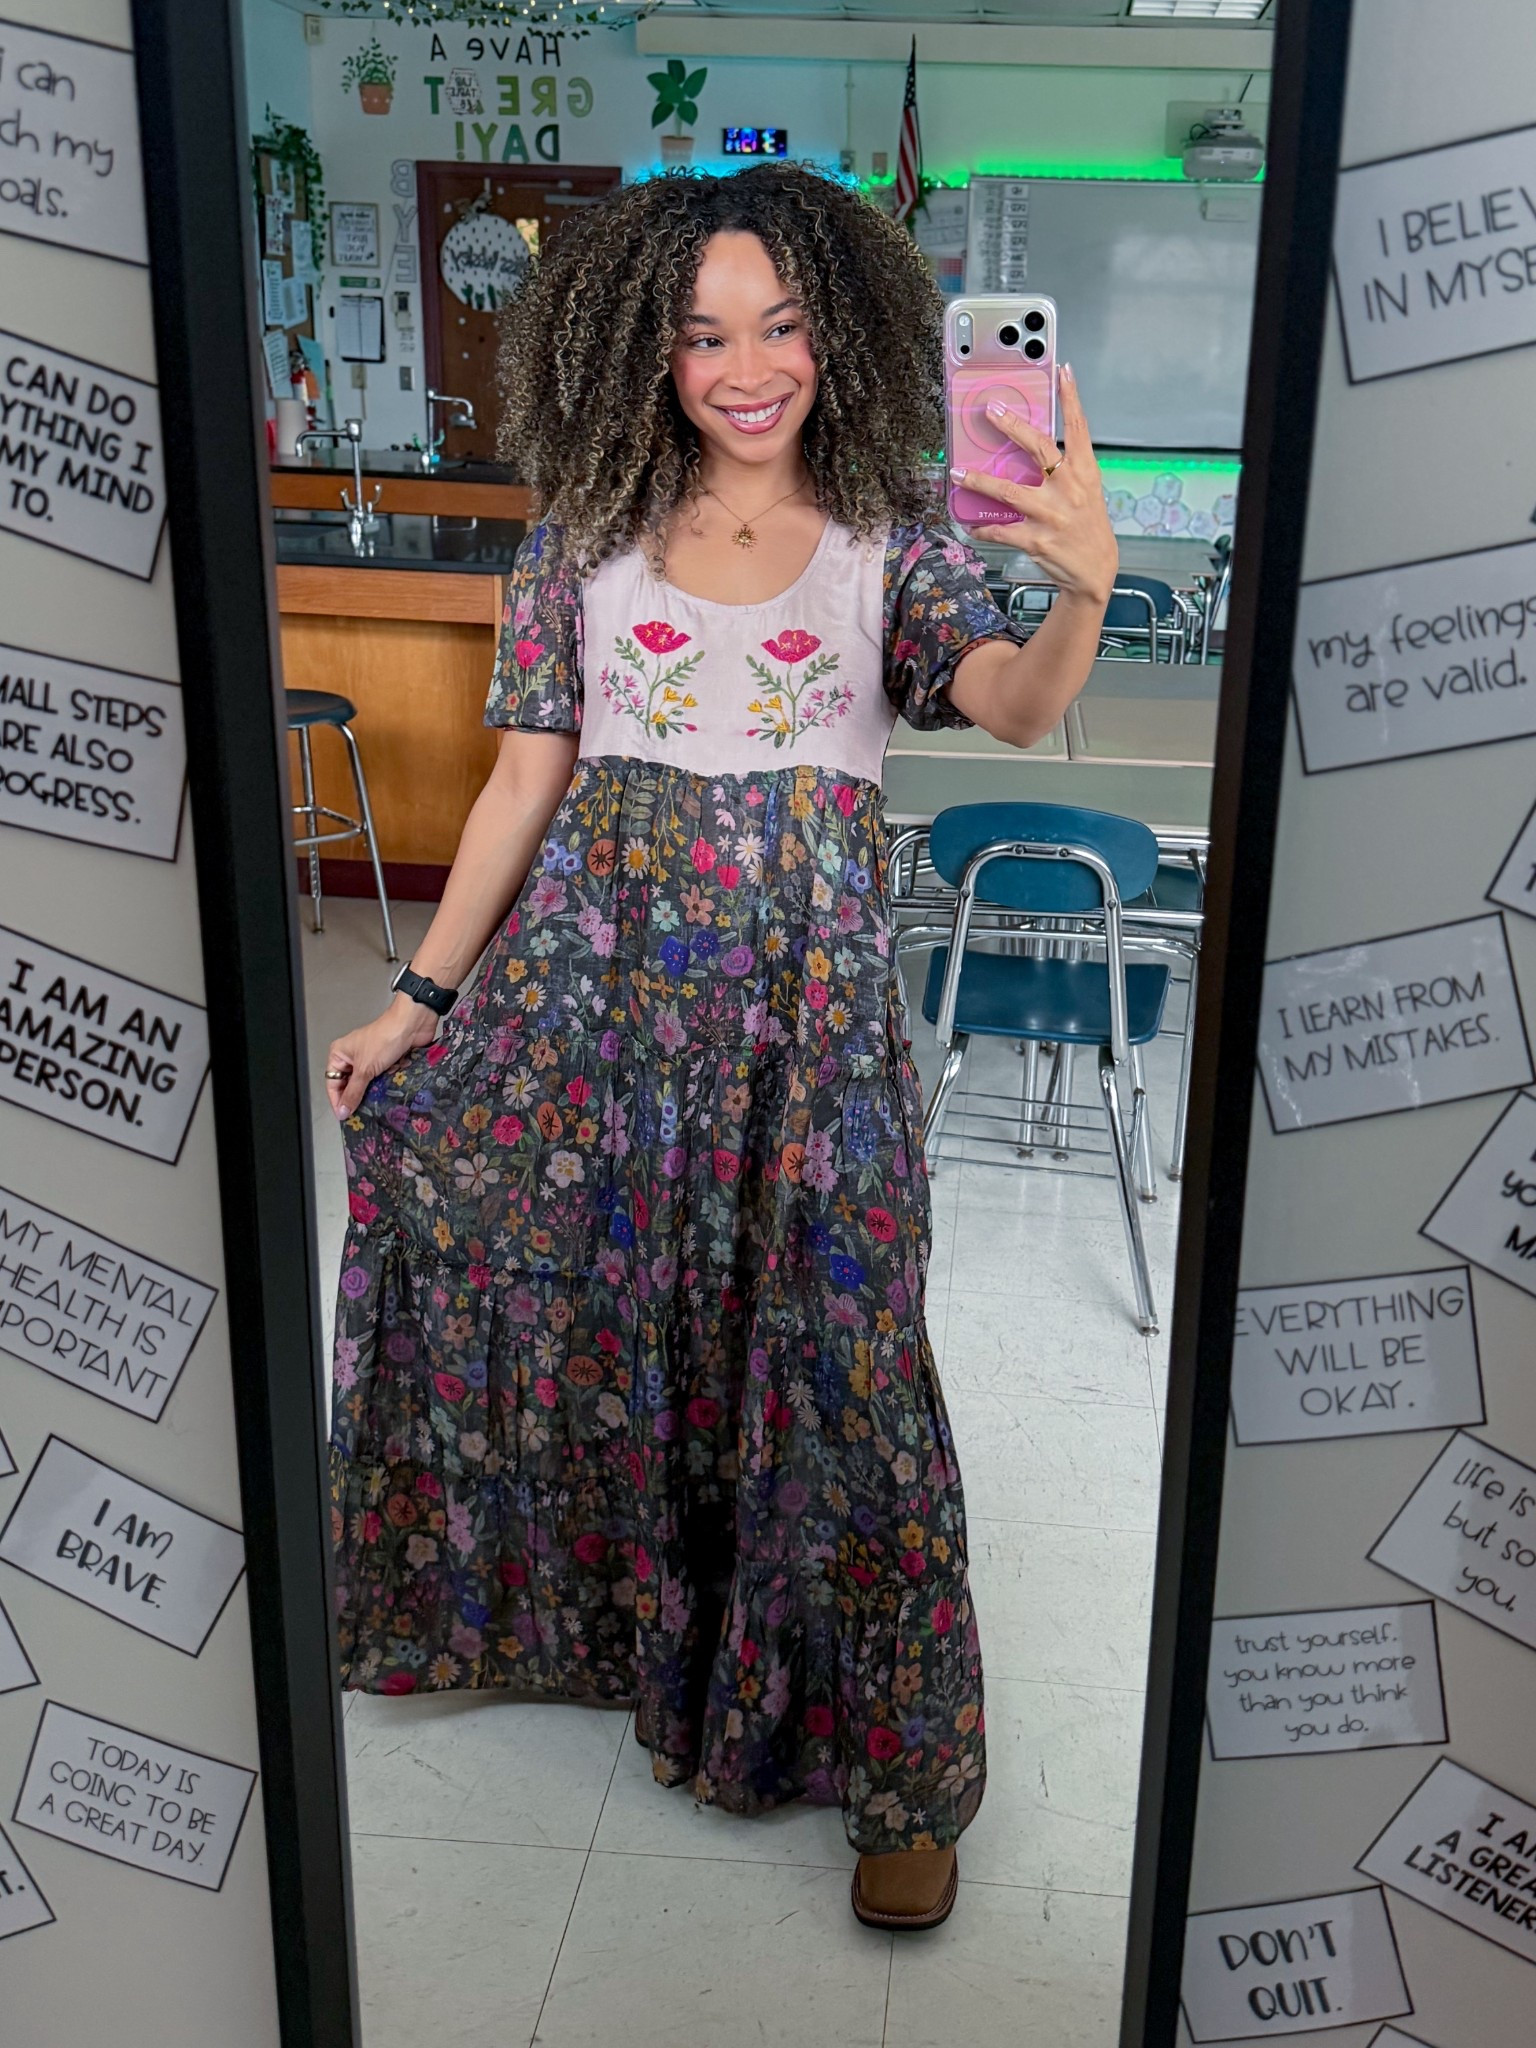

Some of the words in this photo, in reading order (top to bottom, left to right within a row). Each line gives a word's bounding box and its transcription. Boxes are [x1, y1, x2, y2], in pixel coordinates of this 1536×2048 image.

[17, 62, 75, 101] can
[53, 131, 114, 178] my
[0, 178, 68, 217] oals.
[1379, 218, 1389, 258] I
[1364, 272, 1408, 324] IN
[6, 357, 79, 406] CAN
[87, 384, 137, 426] DO
[0, 393, 122, 463] YTHING
[130, 441, 154, 475] I
[0, 434, 50, 477] MY
[57, 457, 155, 515] MIND
[10, 478, 54, 523] TO.
[1308, 631, 1376, 669] my
[1346, 678, 1409, 712] are
[1422, 647, 1527, 701] valid.
[70, 689, 167, 738] STEPS
[0, 719, 42, 754] RE
[50, 733, 134, 773] ALSO
[0, 765, 141, 824] OGRESS.
[8, 958, 35, 995] I
[41, 976, 110, 1026] AM
[119, 1008, 182, 1053] AN
[1278, 1008, 1293, 1039] I
[1299, 991, 1385, 1035] LEARN
[1393, 972, 1485, 1016] FROM
[0, 997, 179, 1094] AMAZING
[1283, 1044, 1332, 1082] MY
[1342, 1012, 1500, 1071] MISTAKES.
[0, 1038, 143, 1127] PERSON.
[0, 1208, 54, 1253] MY
[59, 1240, 193, 1327] MENTAL
[0, 1254, 128, 1339] HEALTH
[132, 1321, 166, 1356] IS
[1234, 1286, 1465, 1337] EVERYTHING
[0, 1300, 168, 1399] PORTANT
[1274, 1341, 1368, 1376] WILL
[1381, 1334, 1425, 1368] BE
[1300, 1380, 1415, 1417] OKAY.
[93, 1498, 111, 1527] I
[1452, 1459, 1504, 1500] life
[1508, 1487, 1536, 1518] is
[1443, 1500, 1498, 1549] but
[56, 1528, 167, 1609] BRAVE.
[1455, 1566, 1516, 1612] you.
[1235, 1631, 1290, 1654] trust
[1296, 1621, 1398, 1654] yourself.
[1224, 1667, 1268, 1688] you
[1275, 1662, 1346, 1681] know
[1353, 1654, 1416, 1673] more
[1239, 1693, 1292, 1713] than
[1298, 1692, 1344, 1712] you
[1350, 1683, 1409, 1703] think
[1285, 1722, 1329, 1742] you
[1337, 1713, 1370, 1733] do.
[87, 1736, 172, 1785] TODAY
[174, 1768, 200, 1795] IS
[38, 1793, 55, 1815] A
[65, 1800, 148, 1846] GREAT
[50, 1760, 137, 1807] GOING
[146, 1793, 181, 1824] TO
[187, 1808, 216, 1836] BE
[1435, 1829, 1461, 1854] A
[1477, 1812, 1505, 1838] I
[1247, 1976, 1343, 2021] QUIT.
